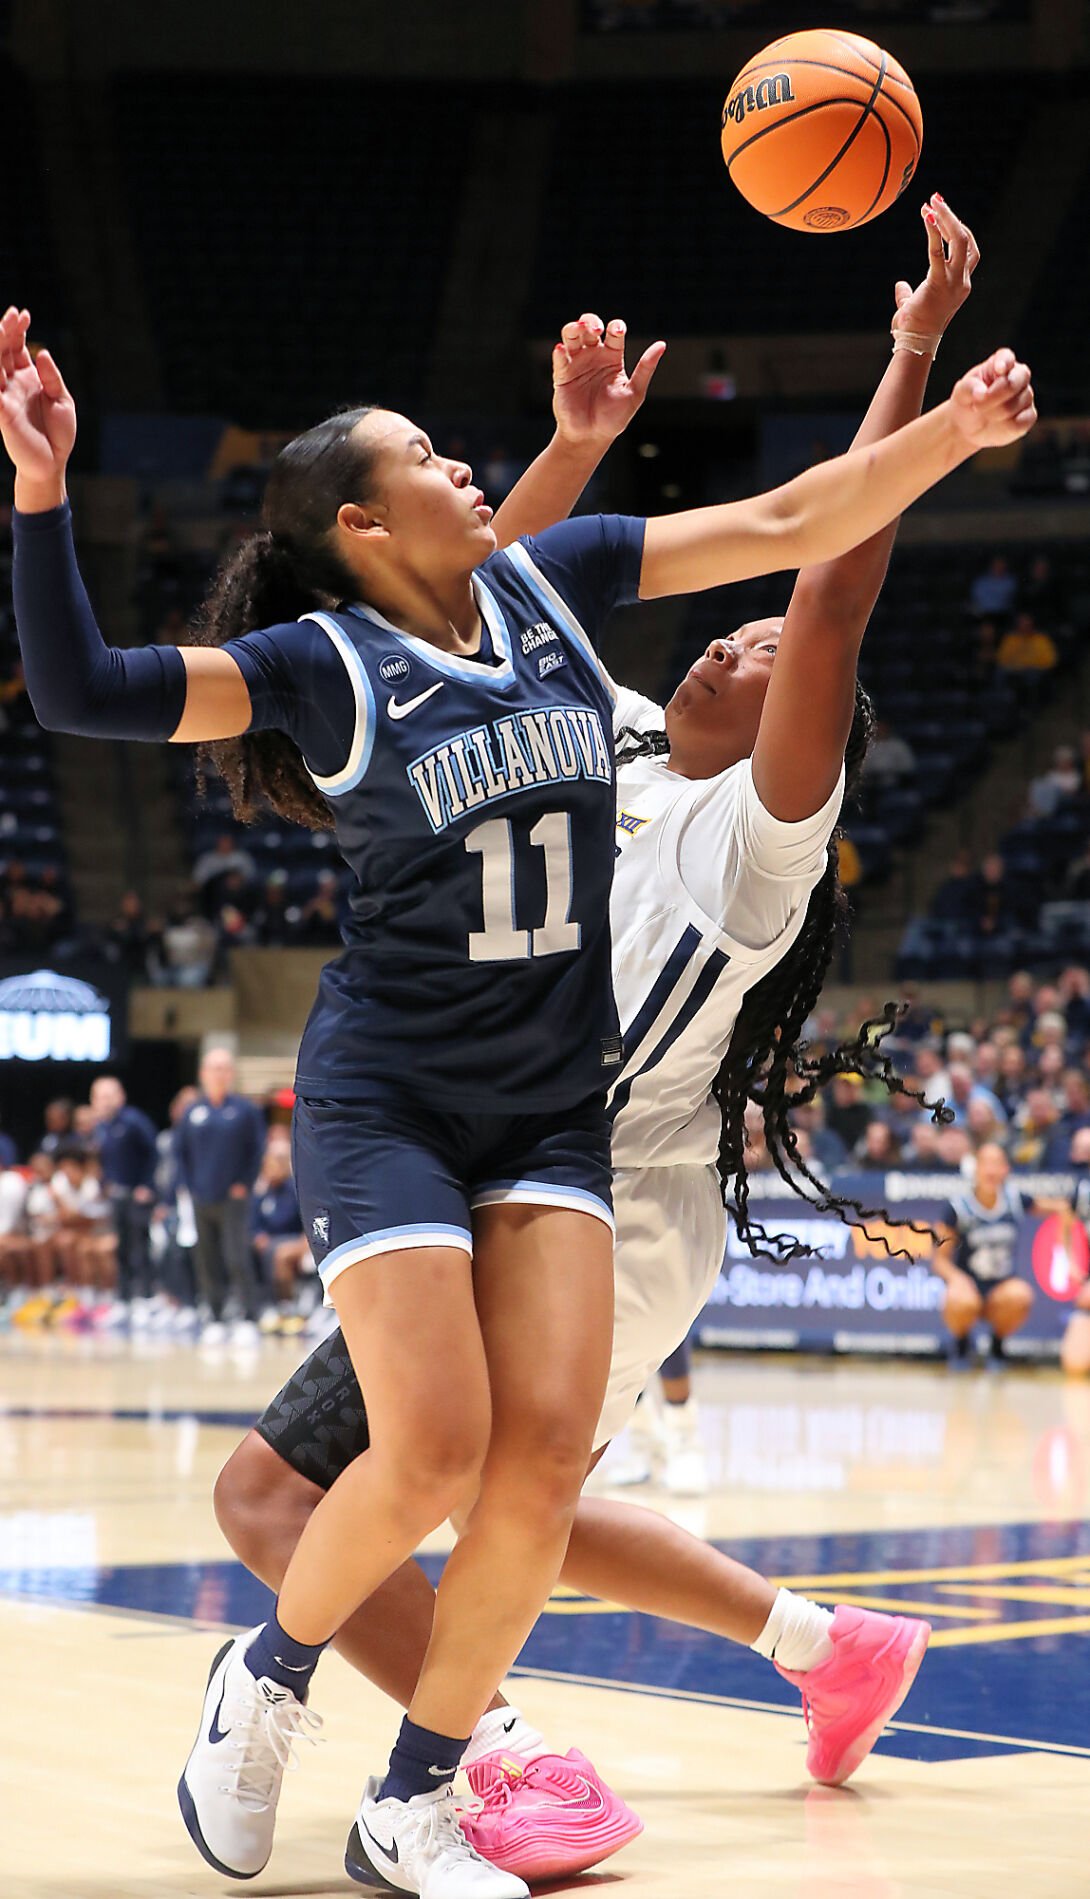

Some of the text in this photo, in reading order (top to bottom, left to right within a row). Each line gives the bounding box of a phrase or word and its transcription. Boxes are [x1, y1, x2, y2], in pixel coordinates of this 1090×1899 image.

[520, 628, 534, 644] BE
[382, 660, 407, 679] MMG
[407, 706, 611, 834] VILLANOVA
[464, 811, 582, 961] 11
[802, 1264, 866, 1309] And
